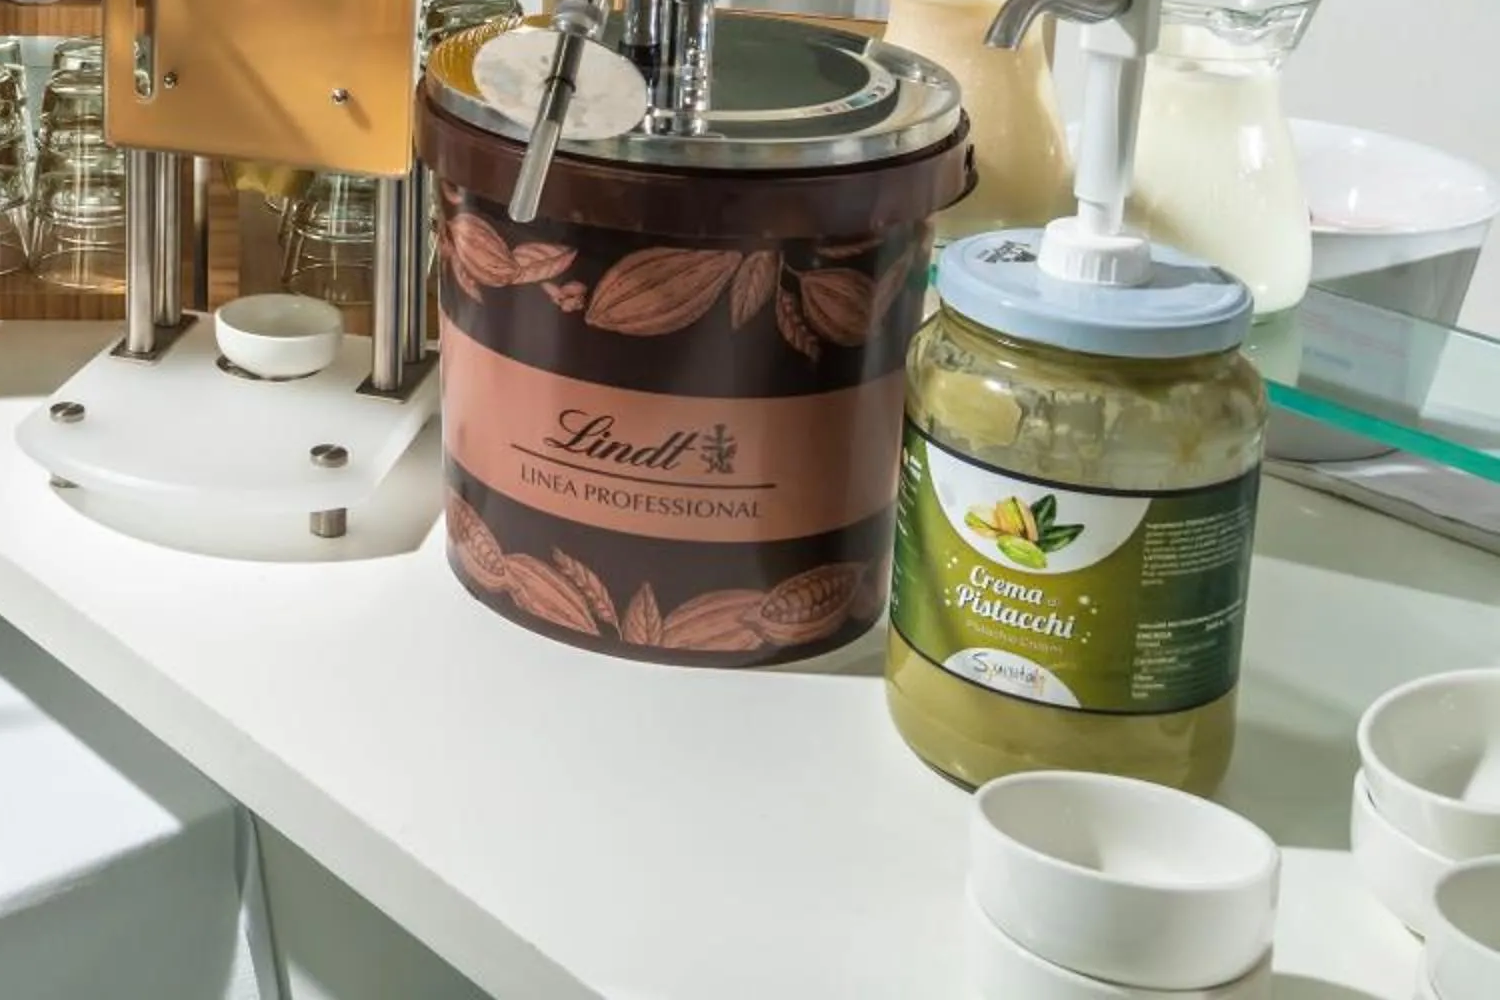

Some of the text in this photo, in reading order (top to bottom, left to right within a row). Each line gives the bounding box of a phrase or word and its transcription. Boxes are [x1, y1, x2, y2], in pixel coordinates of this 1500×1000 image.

[543, 408, 700, 471] Lindt
[520, 463, 762, 520] LINEA PROFESSIONAL
[956, 584, 1076, 639] Pistacchi
[970, 565, 1045, 605] Crema
